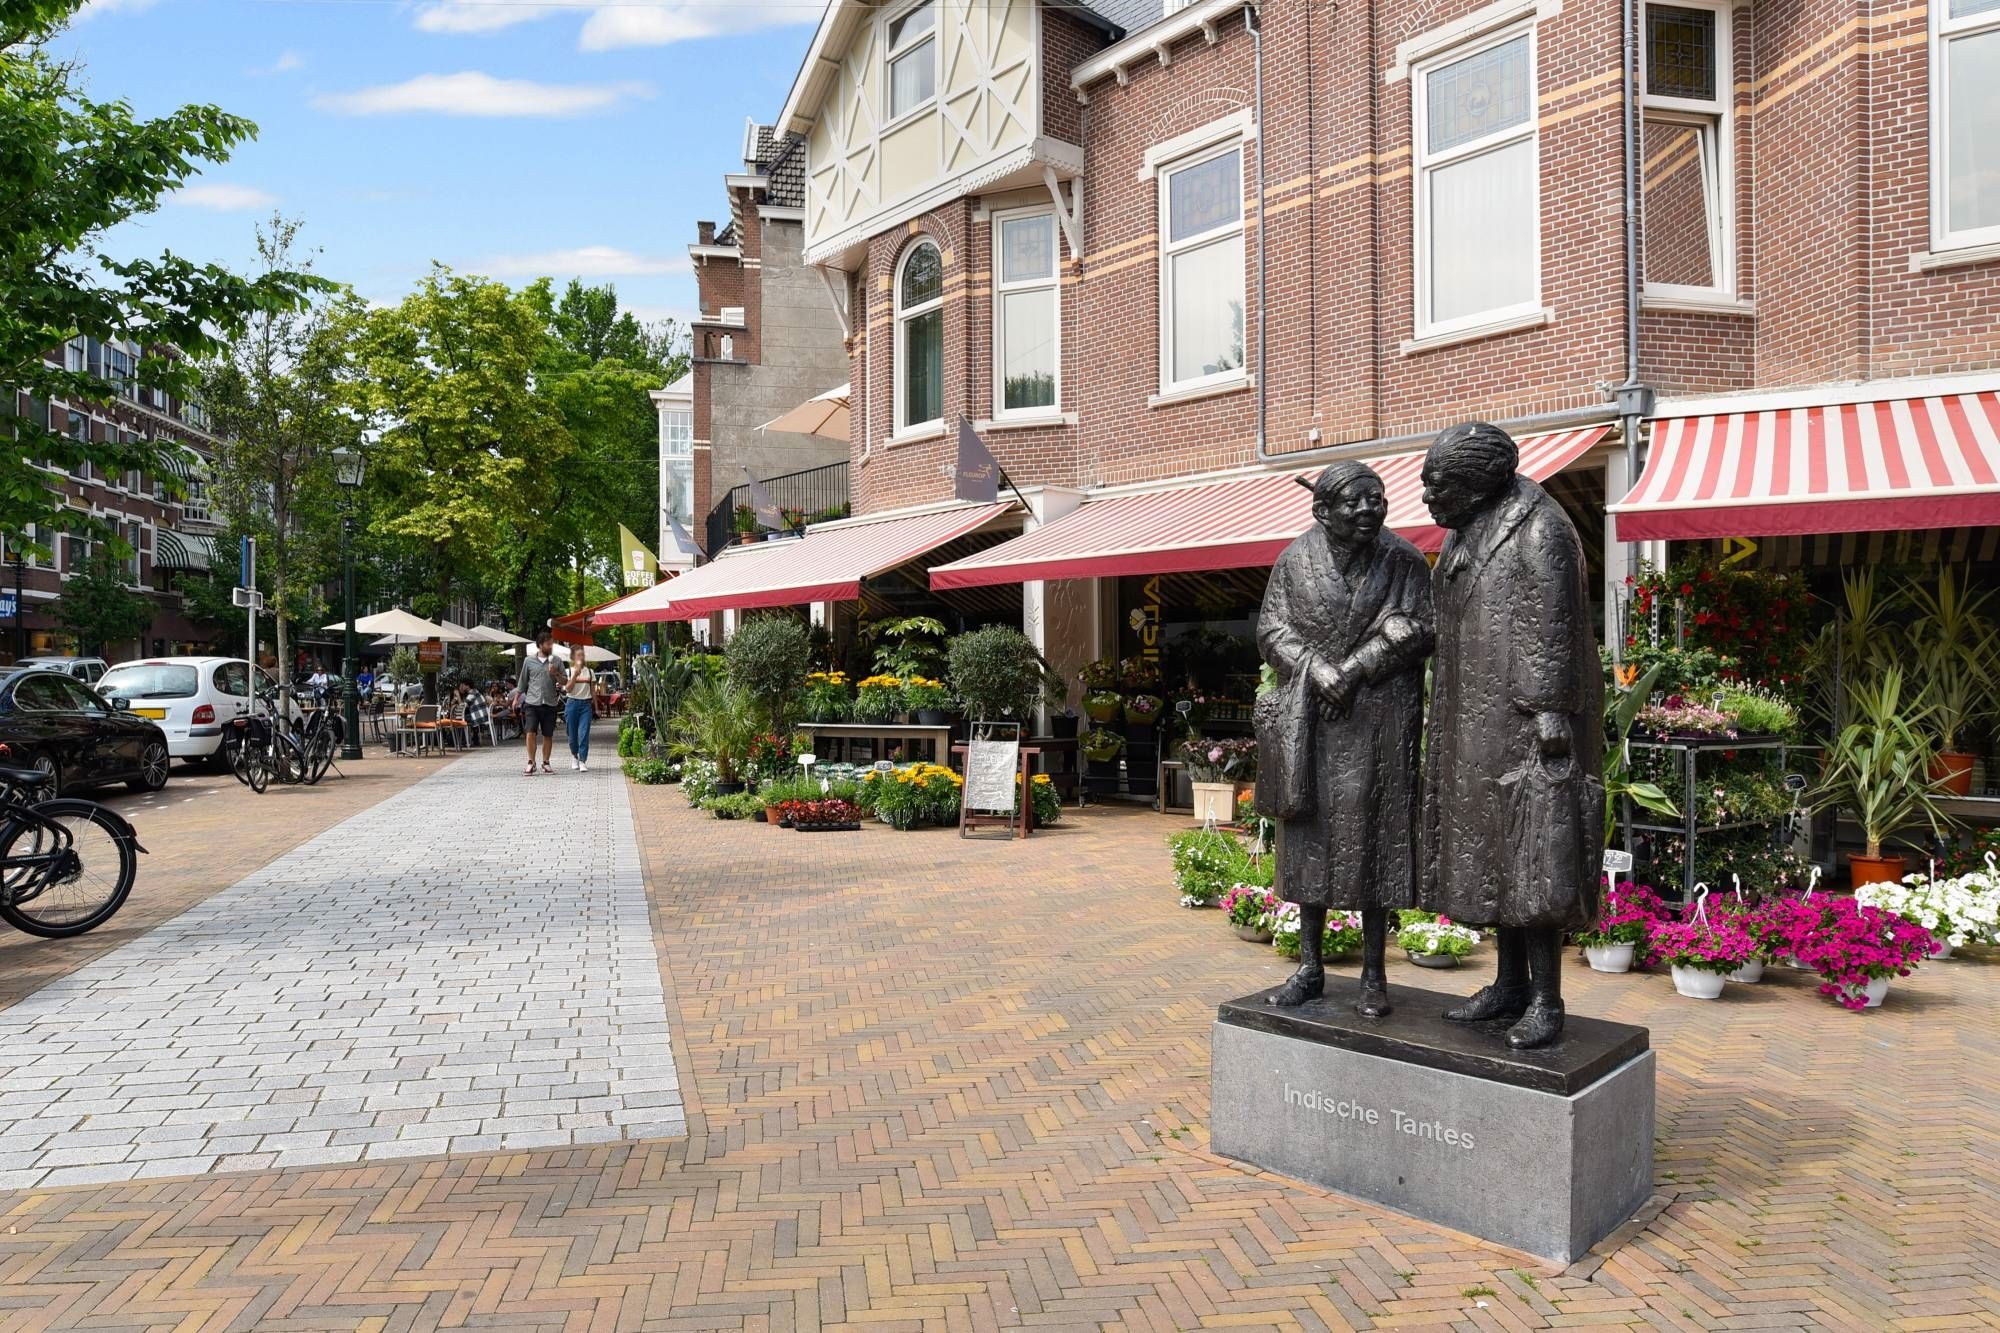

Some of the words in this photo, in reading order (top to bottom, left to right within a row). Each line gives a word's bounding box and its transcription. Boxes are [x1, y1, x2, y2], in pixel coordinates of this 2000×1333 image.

[624, 570, 655, 579] COFFEE
[624, 578, 639, 588] TO
[641, 578, 655, 588] GO
[1284, 1083, 1379, 1125] Indische
[1390, 1109, 1475, 1150] Tantes
